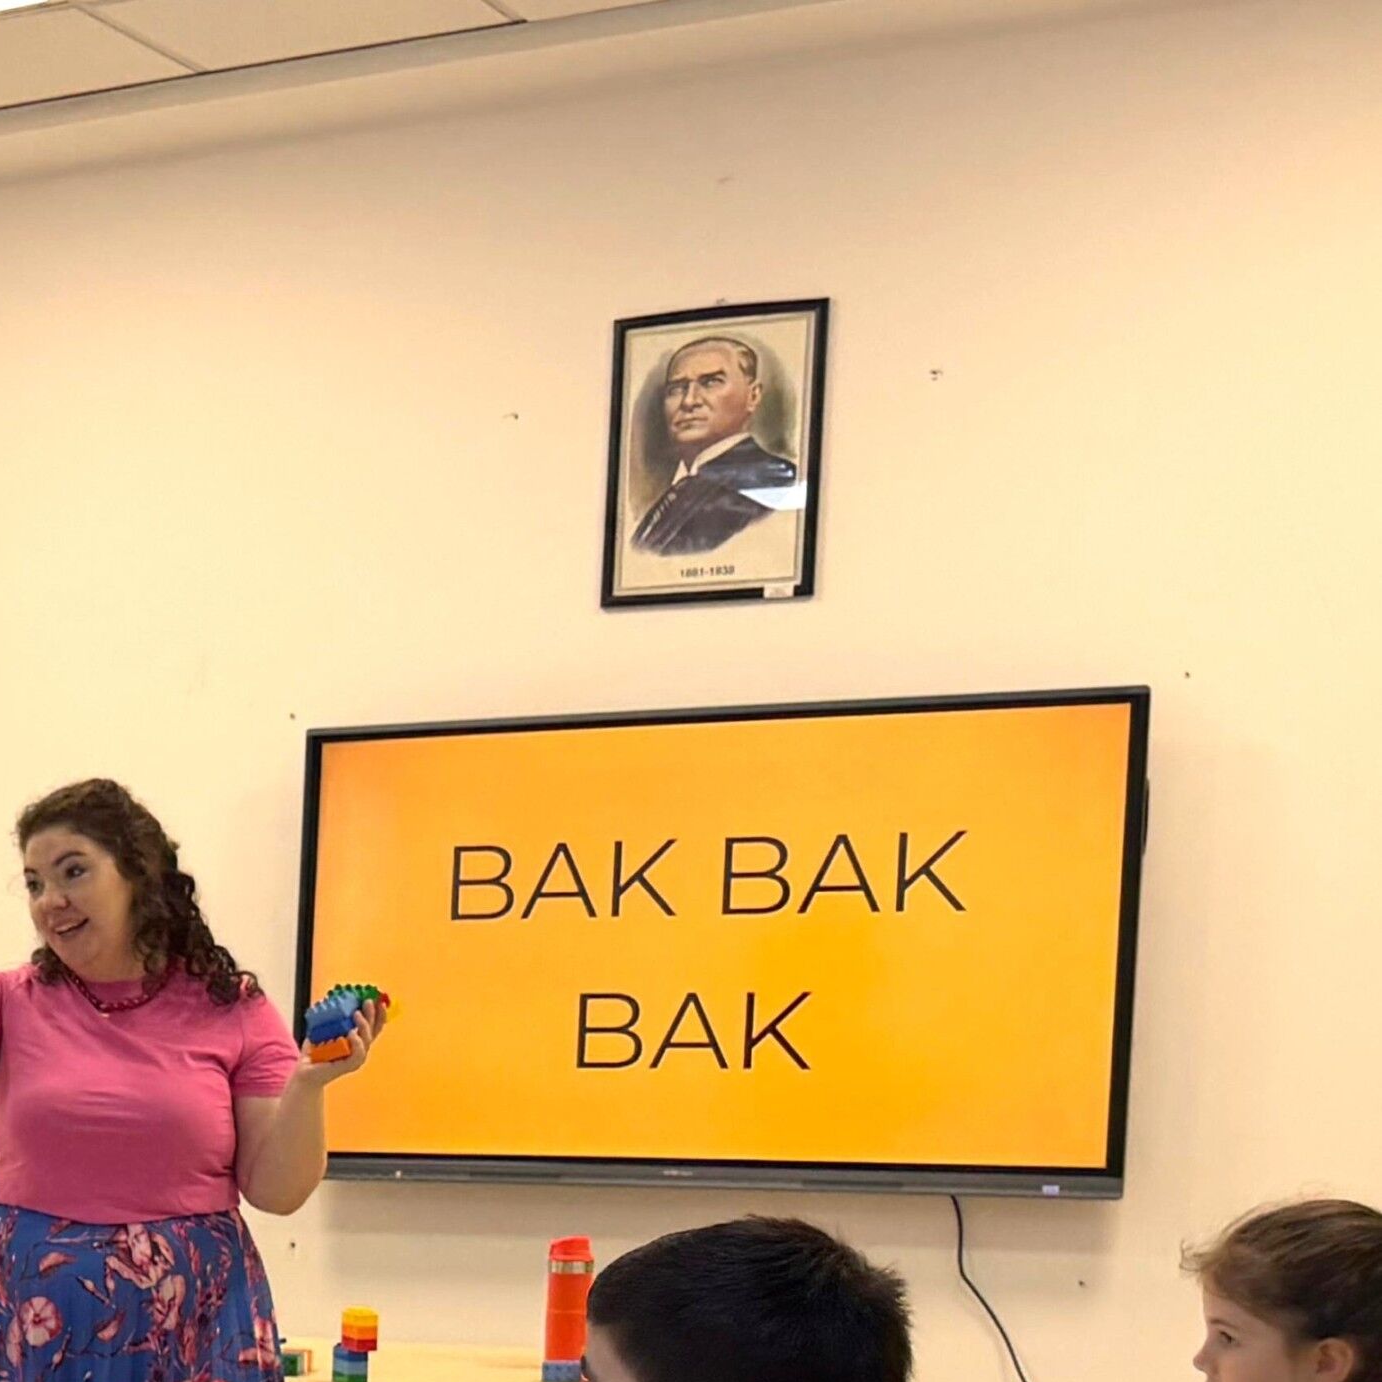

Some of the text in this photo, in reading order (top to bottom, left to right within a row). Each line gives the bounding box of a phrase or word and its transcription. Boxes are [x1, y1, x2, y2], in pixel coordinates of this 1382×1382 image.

[450, 831, 967, 921] BAK BAK
[575, 991, 812, 1071] BAK
